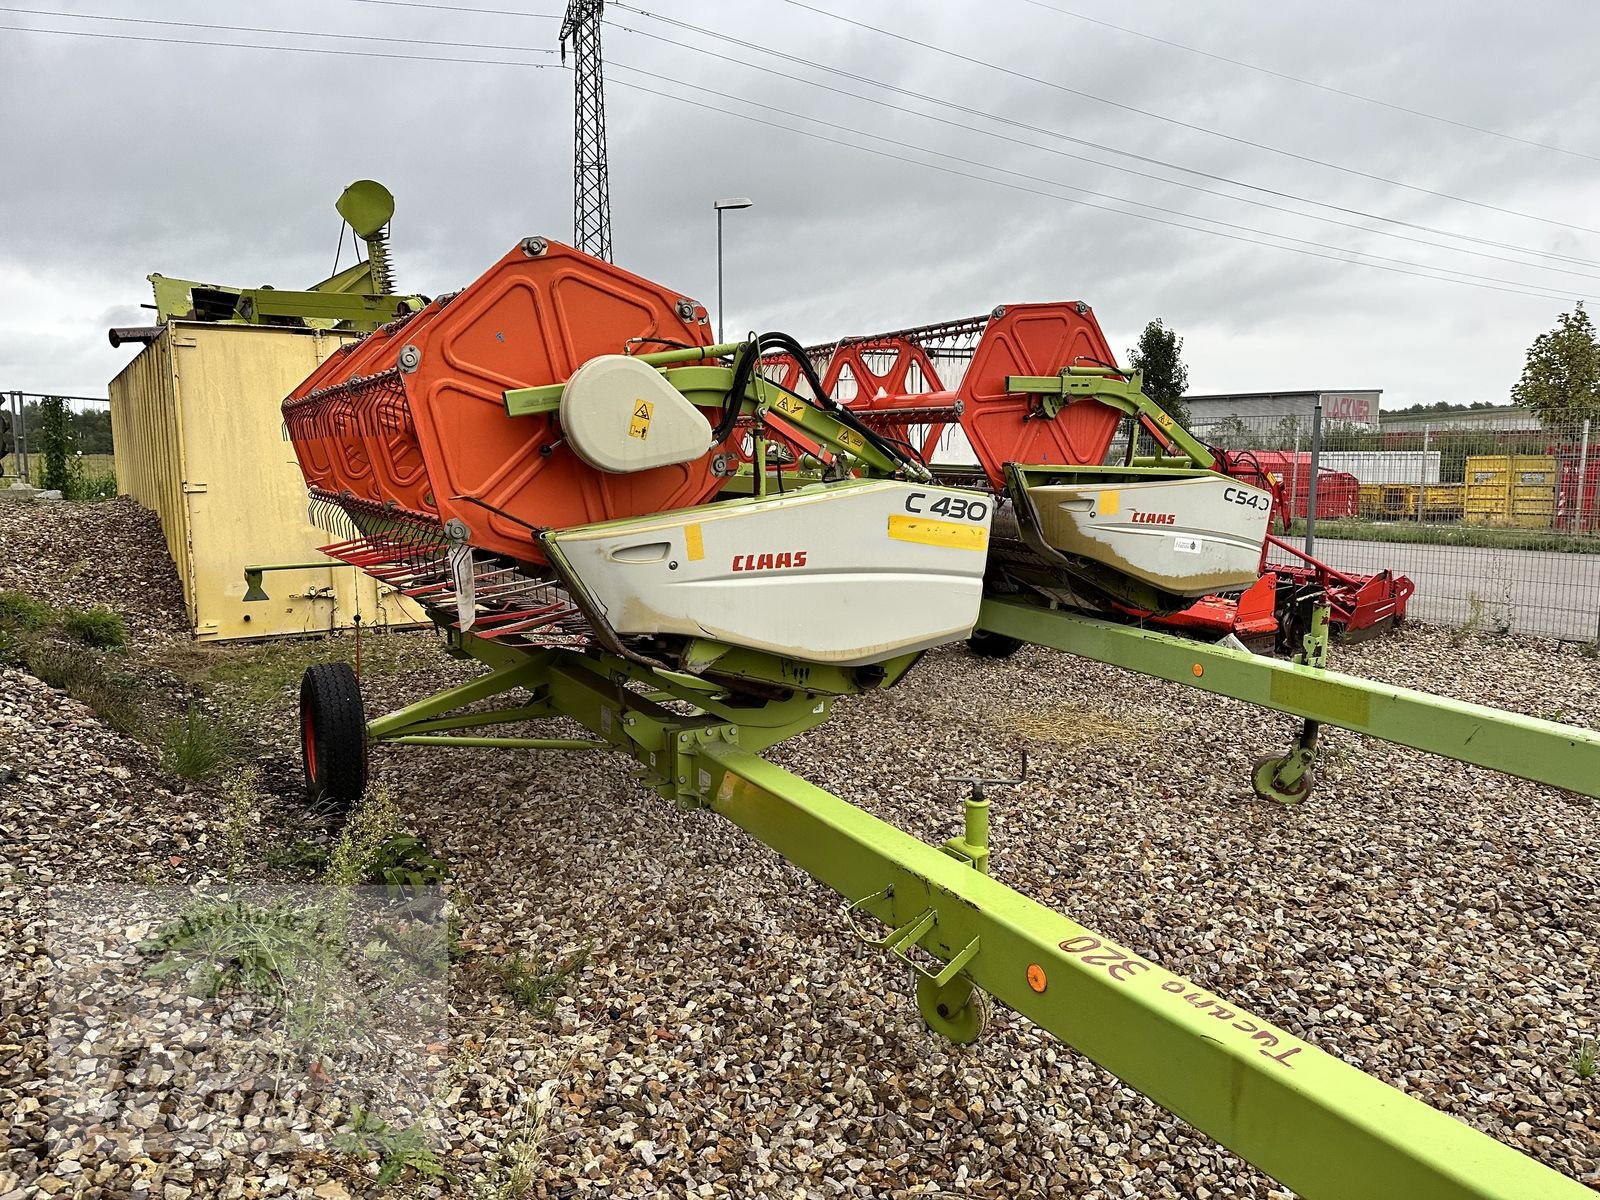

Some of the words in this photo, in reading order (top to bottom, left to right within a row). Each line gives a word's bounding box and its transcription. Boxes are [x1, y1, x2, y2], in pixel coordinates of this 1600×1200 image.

[905, 493, 926, 513] C
[930, 497, 987, 521] 430
[1131, 511, 1176, 525] CLAAS
[732, 551, 807, 572] CLAAS
[1058, 936, 1151, 982] 320
